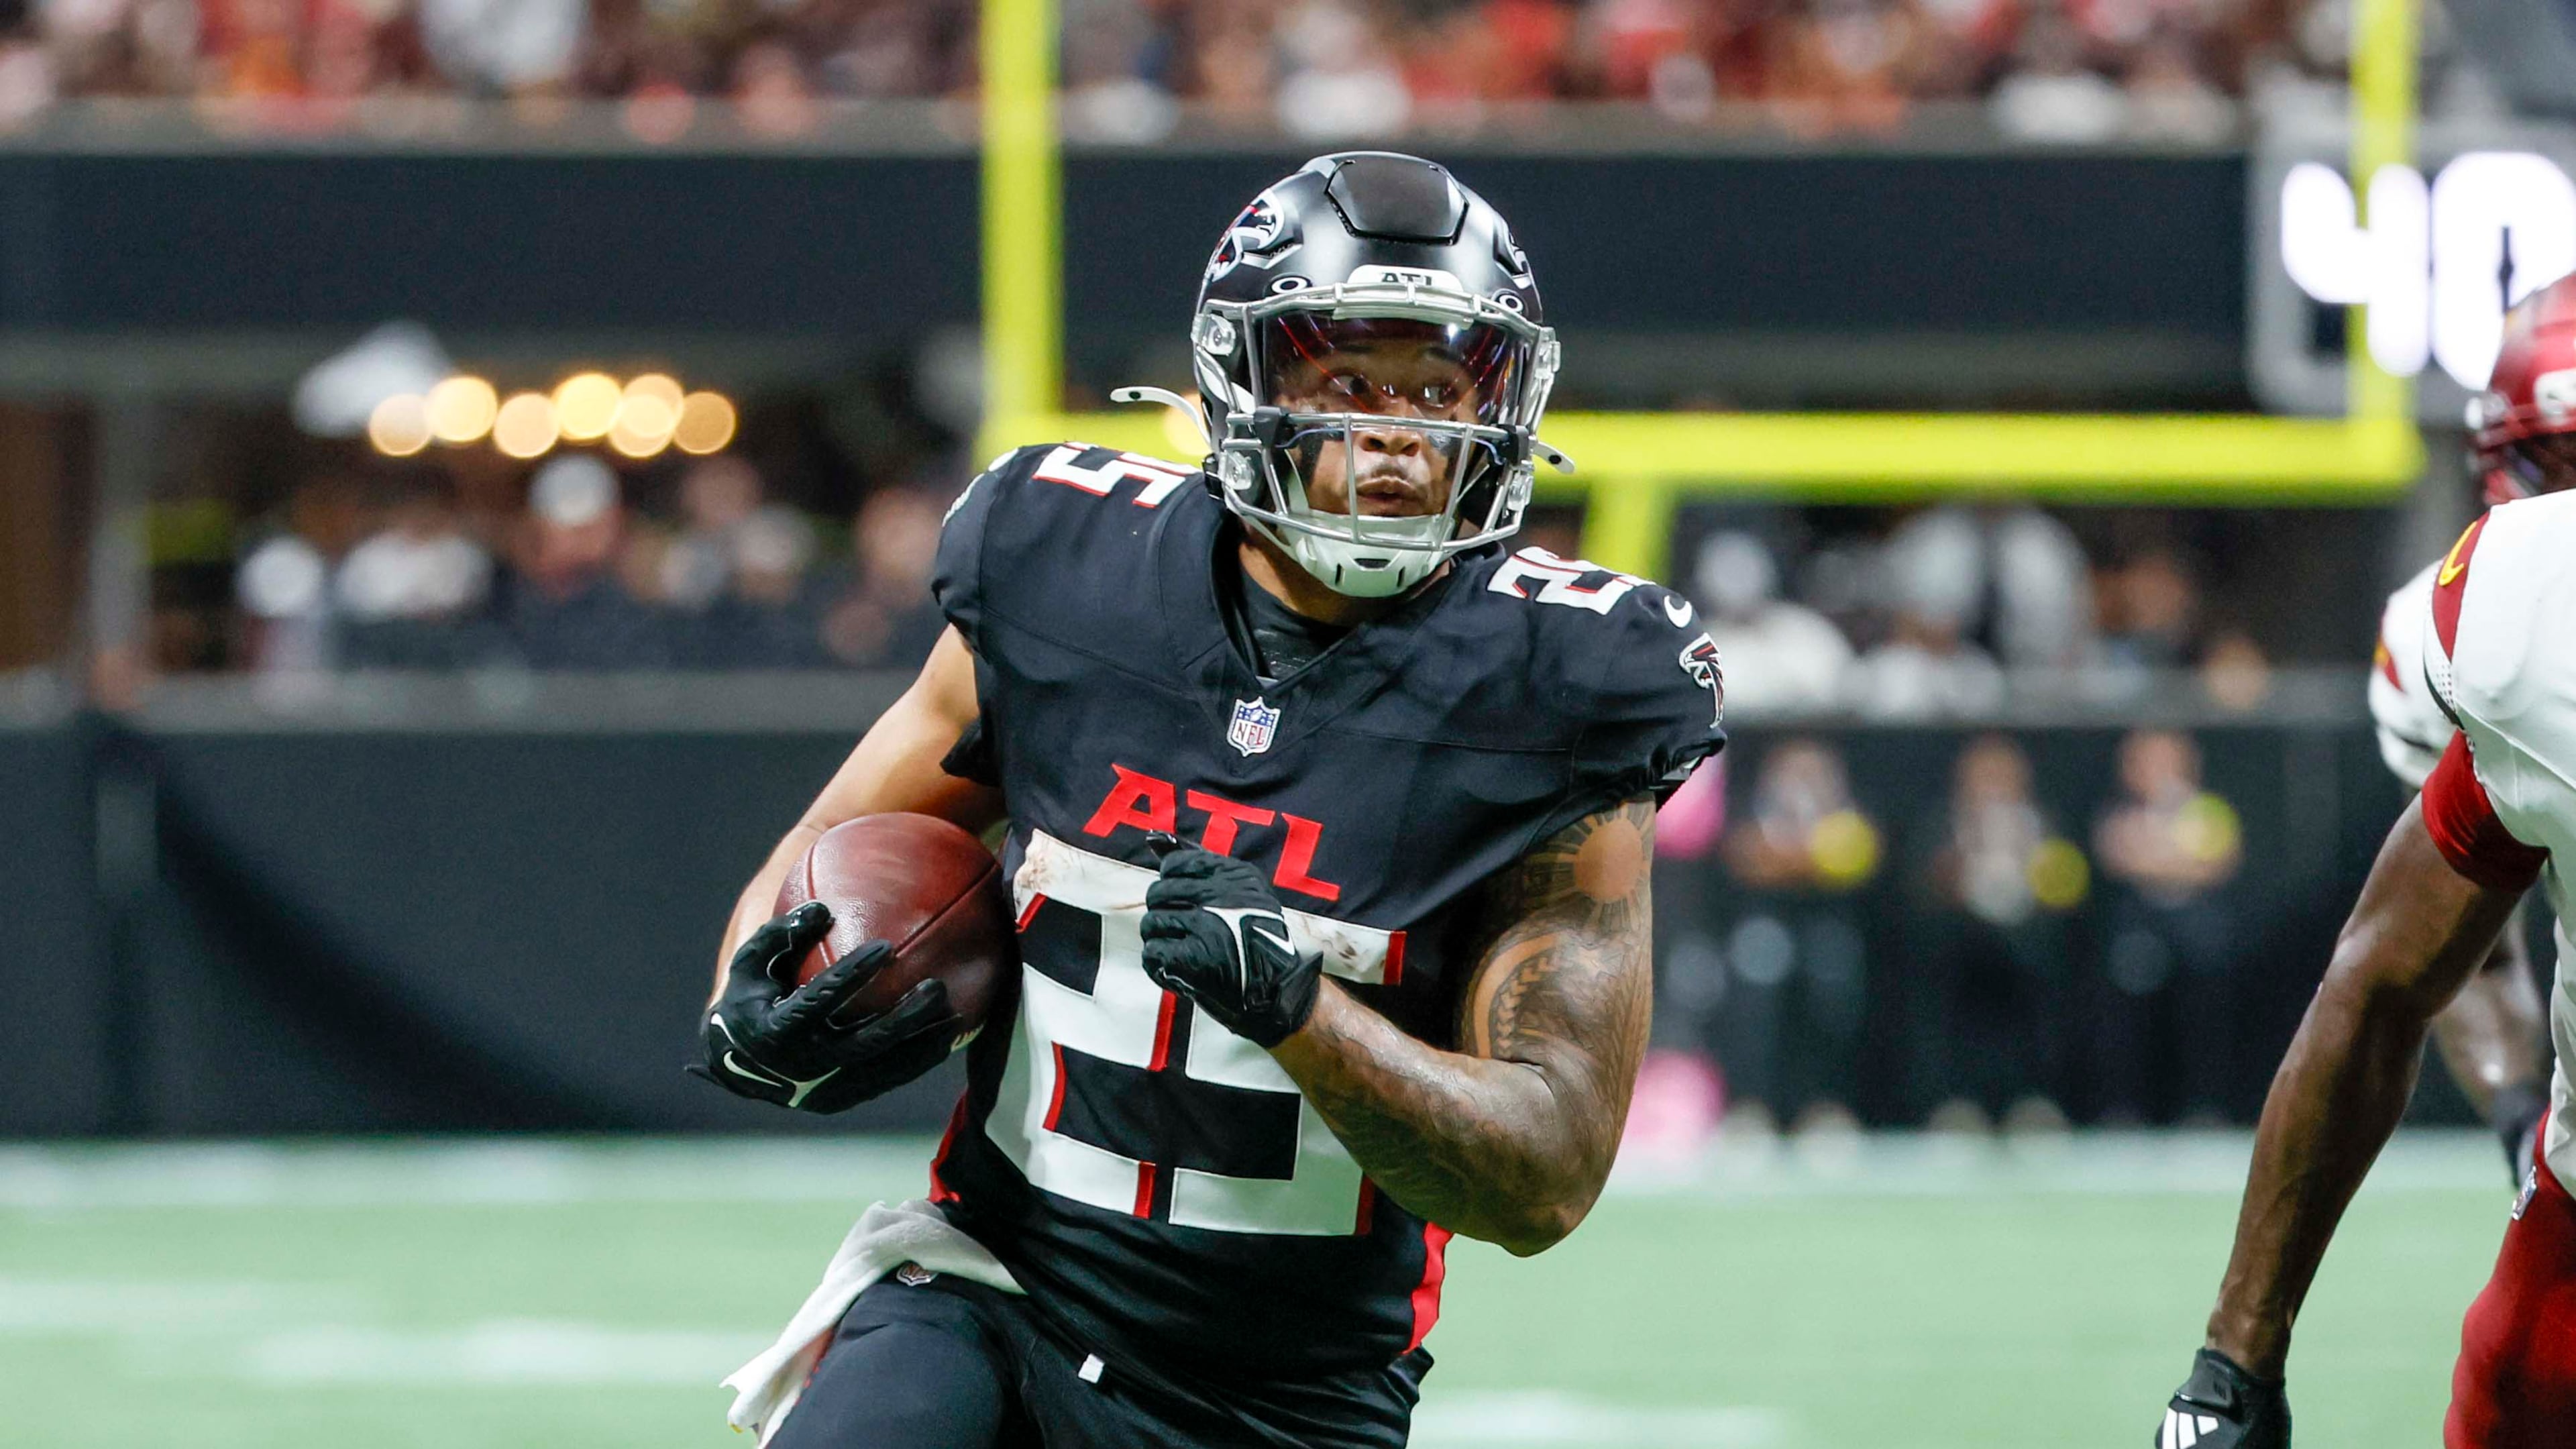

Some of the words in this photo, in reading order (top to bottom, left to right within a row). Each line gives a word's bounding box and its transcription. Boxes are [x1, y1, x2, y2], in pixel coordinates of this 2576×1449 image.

[2282, 152, 2575, 390] 40
[1236, 722, 1266, 746] NFL
[1083, 763, 1340, 902] ATL
[985, 828, 1407, 1237] 25
